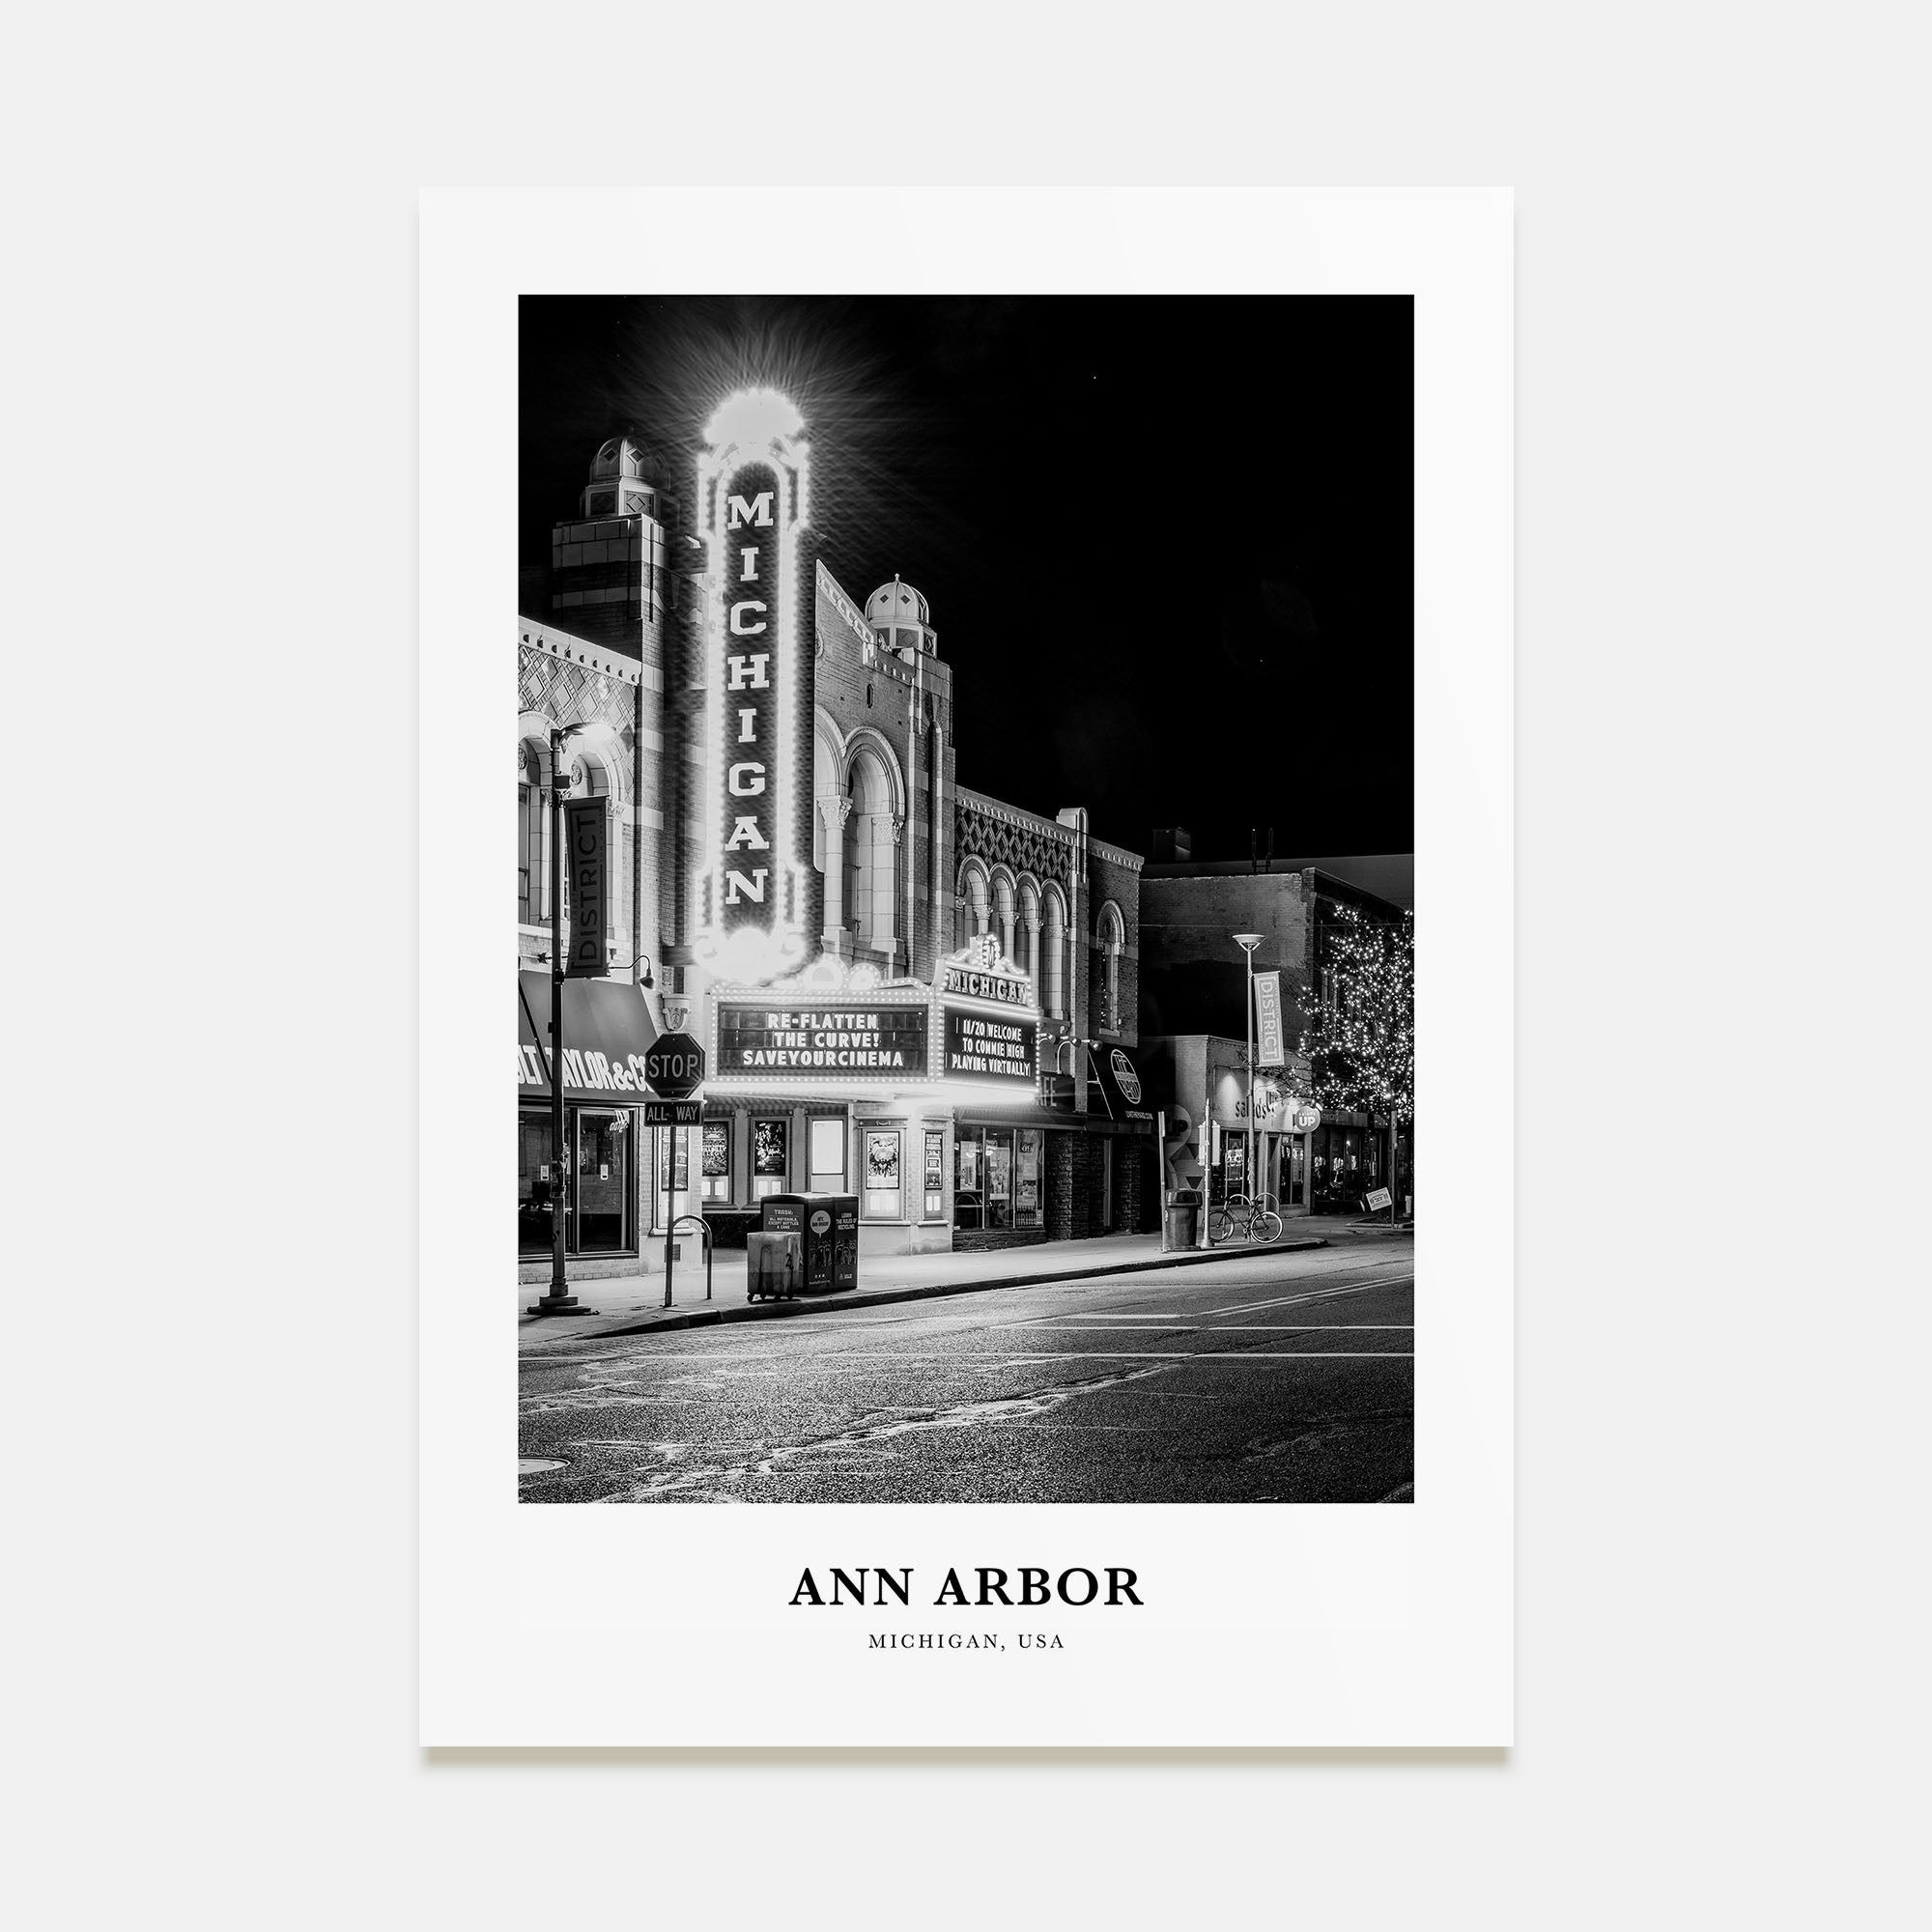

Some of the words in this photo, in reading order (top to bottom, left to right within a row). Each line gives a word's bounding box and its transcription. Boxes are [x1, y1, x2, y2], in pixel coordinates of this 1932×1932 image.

[725, 492, 774, 904] MICHIGAN
[576, 814, 598, 960] DISTRICT
[948, 970, 1029, 1005] MICHIGAN
[768, 1013, 878, 1029] RE-FLATTEN
[1260, 981, 1278, 1058] DISTRICT
[774, 1032, 807, 1047] THE
[814, 1032, 880, 1048] CURVE!
[963, 1019, 985, 1037] 11/20
[986, 1022, 1022, 1042] WELCOME
[962, 1037, 974, 1053] TO
[649, 1054, 698, 1078] STOP
[743, 1050, 903, 1066] SAVEYOURCINEMA
[952, 1053, 986, 1072] PLAYING
[676, 1106, 698, 1121] WAY
[1298, 1116, 1316, 1127] UP
[788, 1567, 915, 1605] ANN
[933, 1567, 1145, 1606] ARBOR
[868, 1634, 1006, 1652] MICHIGAN,
[1018, 1634, 1065, 1650] USA
